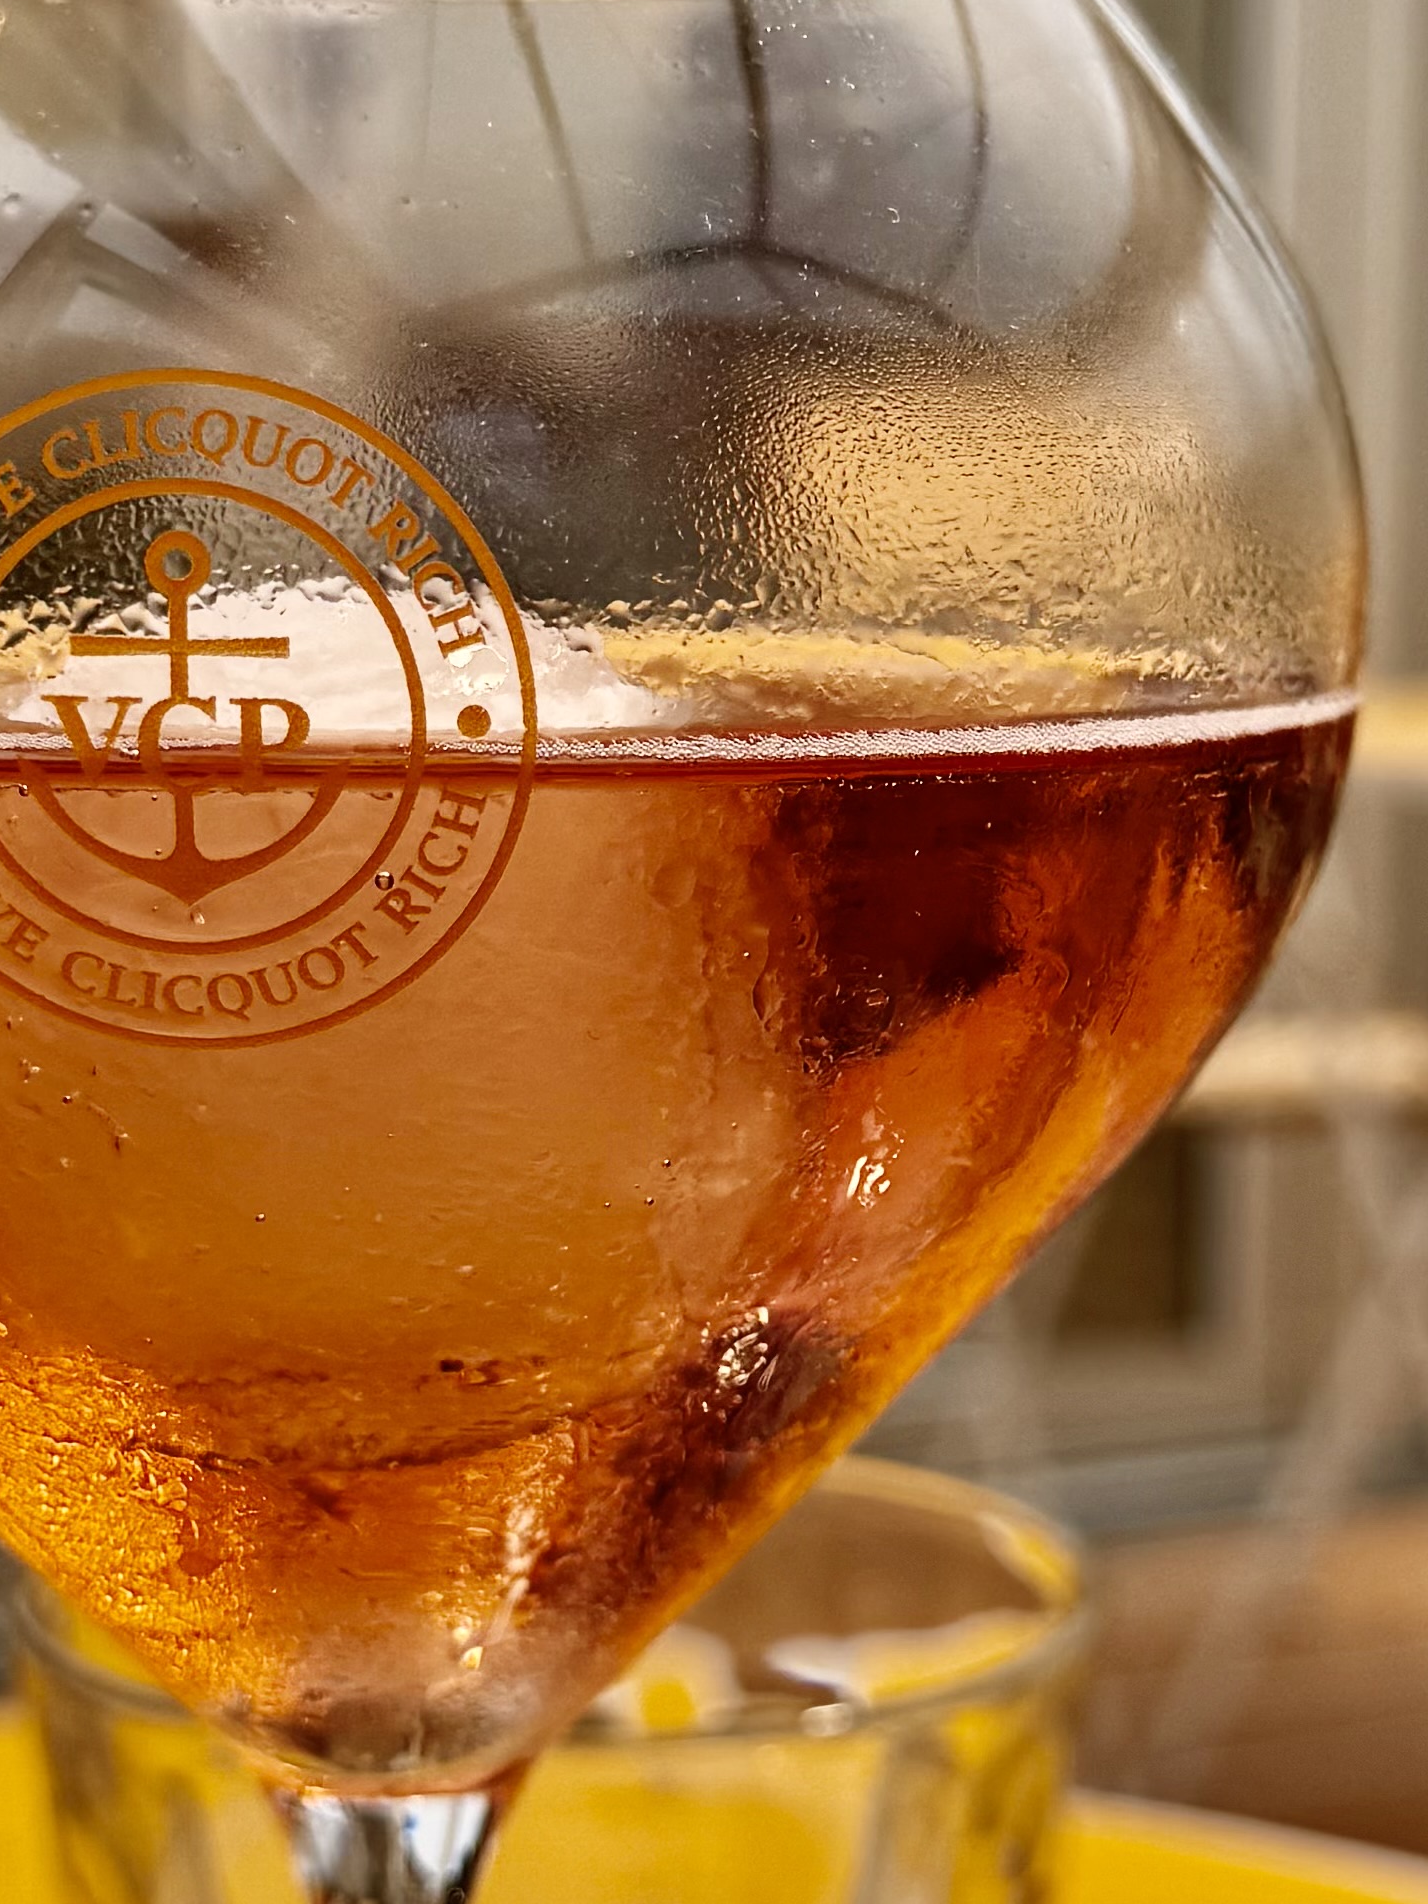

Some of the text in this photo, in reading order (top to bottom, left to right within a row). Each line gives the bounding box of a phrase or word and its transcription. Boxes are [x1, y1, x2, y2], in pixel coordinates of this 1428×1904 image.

[41, 406, 374, 510] CLICQUOT
[367, 502, 484, 658] RICH
[41, 694, 312, 794] VCP
[60, 921, 380, 1021] CLICQUOT
[373, 783, 487, 936] RICH
